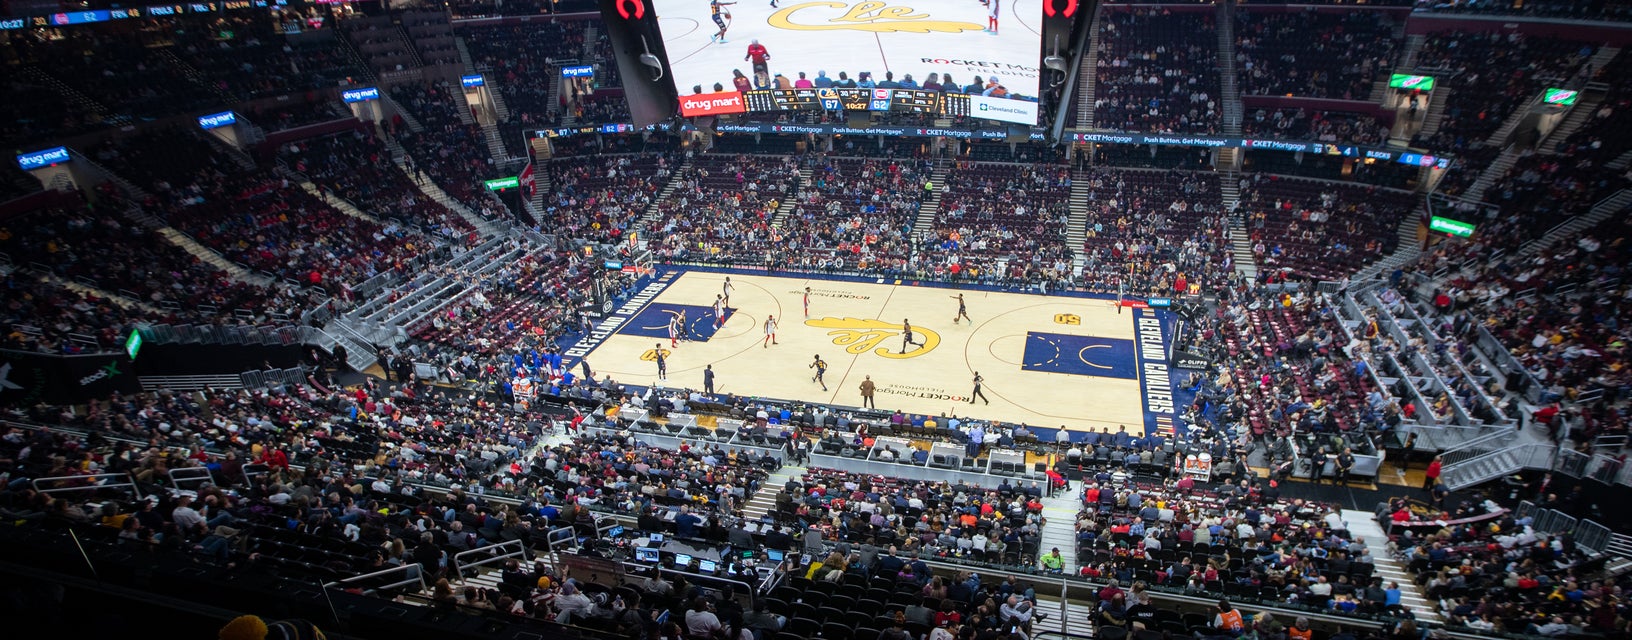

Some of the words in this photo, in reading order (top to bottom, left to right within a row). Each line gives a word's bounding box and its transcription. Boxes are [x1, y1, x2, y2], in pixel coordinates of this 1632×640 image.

[921, 58, 1000, 69] ROCKET
[563, 68, 577, 76] drug
[578, 66, 593, 74] mart
[462, 77, 474, 86] drug
[473, 76, 483, 84] mart
[343, 90, 361, 101] drug
[361, 88, 378, 98] mart
[684, 99, 712, 111] drug
[712, 96, 740, 107] mart
[825, 100, 838, 109] 67
[873, 100, 887, 109] 62
[989, 105, 1013, 113] Cleveland
[200, 115, 218, 127] drug
[606, 125, 615, 133] 62
[796, 126, 823, 134] Mortgage
[943, 129, 971, 137] Mortgage
[1073, 133, 1101, 141] ROCKET
[1101, 134, 1132, 143] Mortgage
[1241, 139, 1272, 148] ROCKET
[1272, 141, 1306, 151] Mortgage
[1344, 147, 1351, 155] 4
[1367, 150, 1391, 159] BLOCKS
[19, 153, 44, 166] drug
[43, 148, 68, 161] mart
[1406, 155, 1413, 163] 0
[616, 282, 667, 315] CAVALIERS
[1138, 317, 1166, 361] CLEVELAND
[1143, 362, 1175, 414] CAVALIERS
[915, 392, 970, 402] ROCKET
